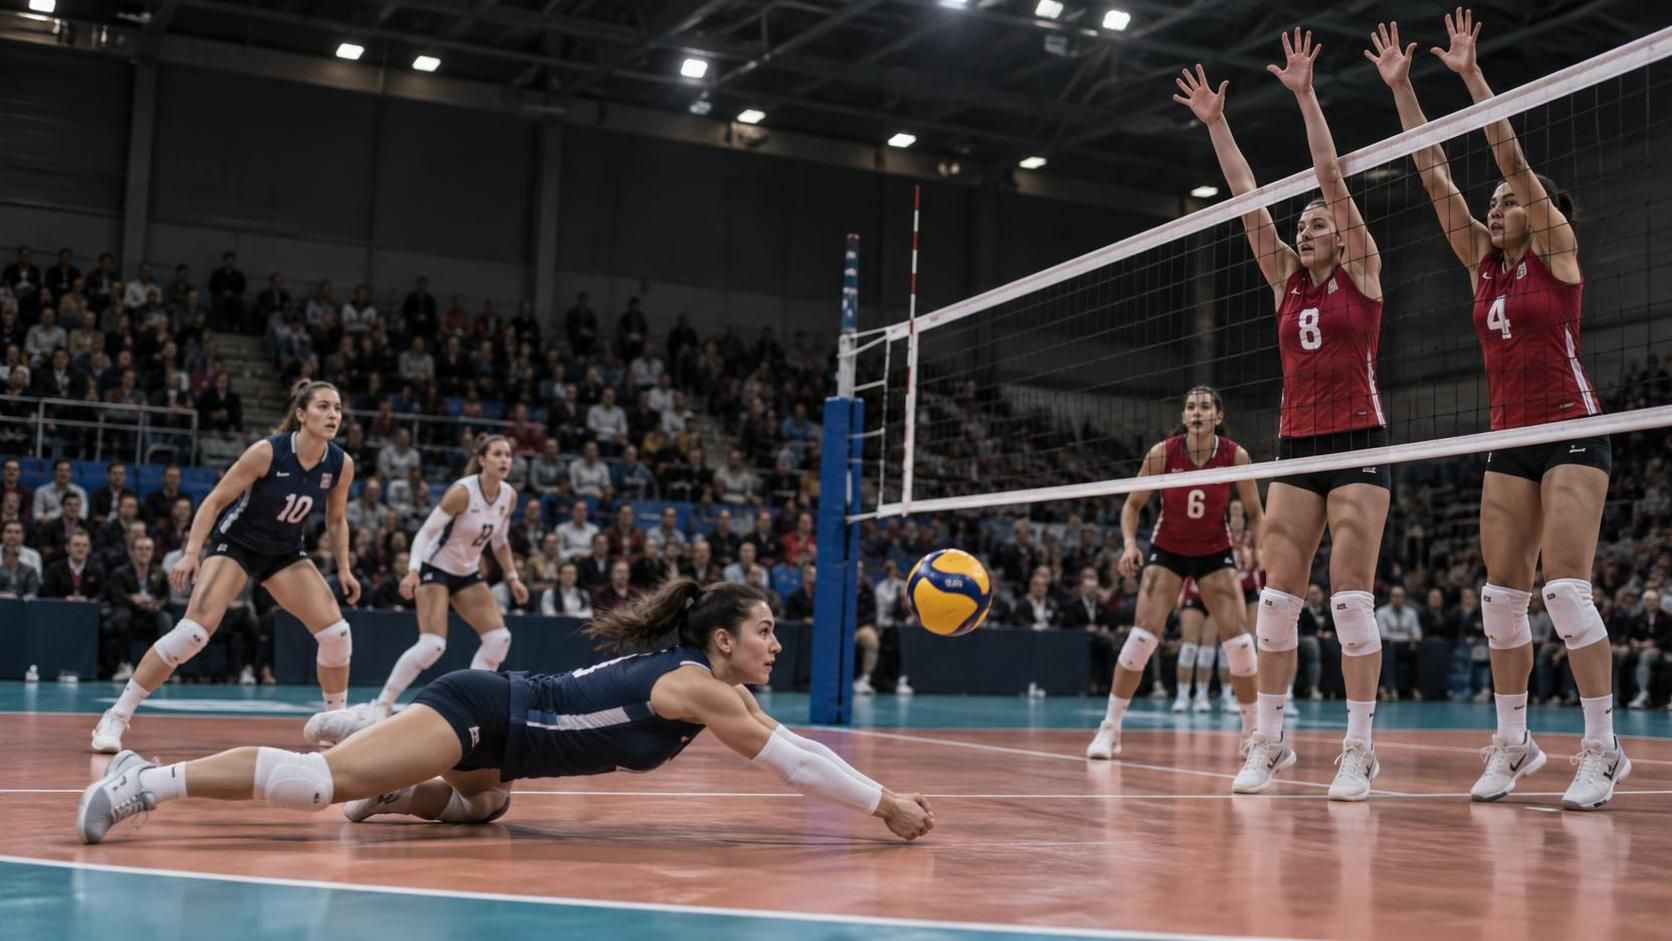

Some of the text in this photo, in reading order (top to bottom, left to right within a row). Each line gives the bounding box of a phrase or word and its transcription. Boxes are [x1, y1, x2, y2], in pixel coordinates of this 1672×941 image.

[1299, 307, 1322, 350] 8
[1487, 294, 1512, 339] 4
[276, 493, 313, 524] 10
[1187, 489, 1206, 519] 6
